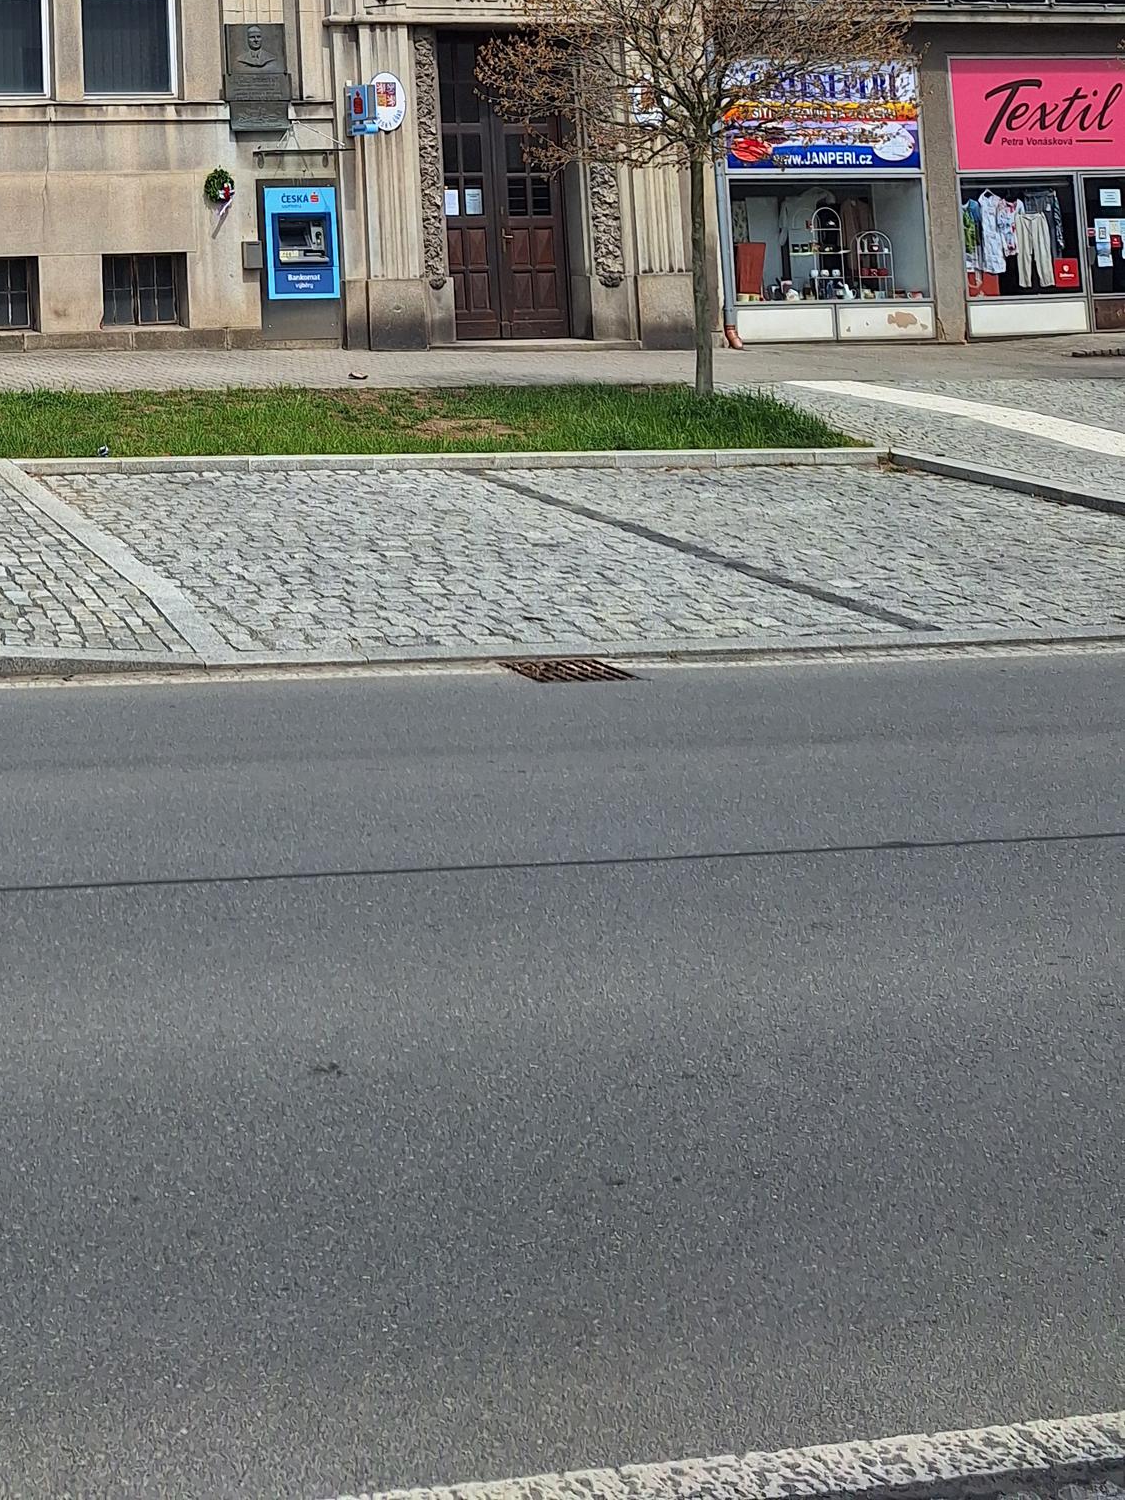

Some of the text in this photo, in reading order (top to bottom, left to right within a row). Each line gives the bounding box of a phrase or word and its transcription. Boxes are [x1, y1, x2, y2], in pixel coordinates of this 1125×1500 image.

[984, 79, 1123, 145] Textil
[1001, 137, 1073, 146] Petra Vonásková
[281, 192, 309, 204] ČESKÁ
[287, 273, 321, 281] Bankomat
